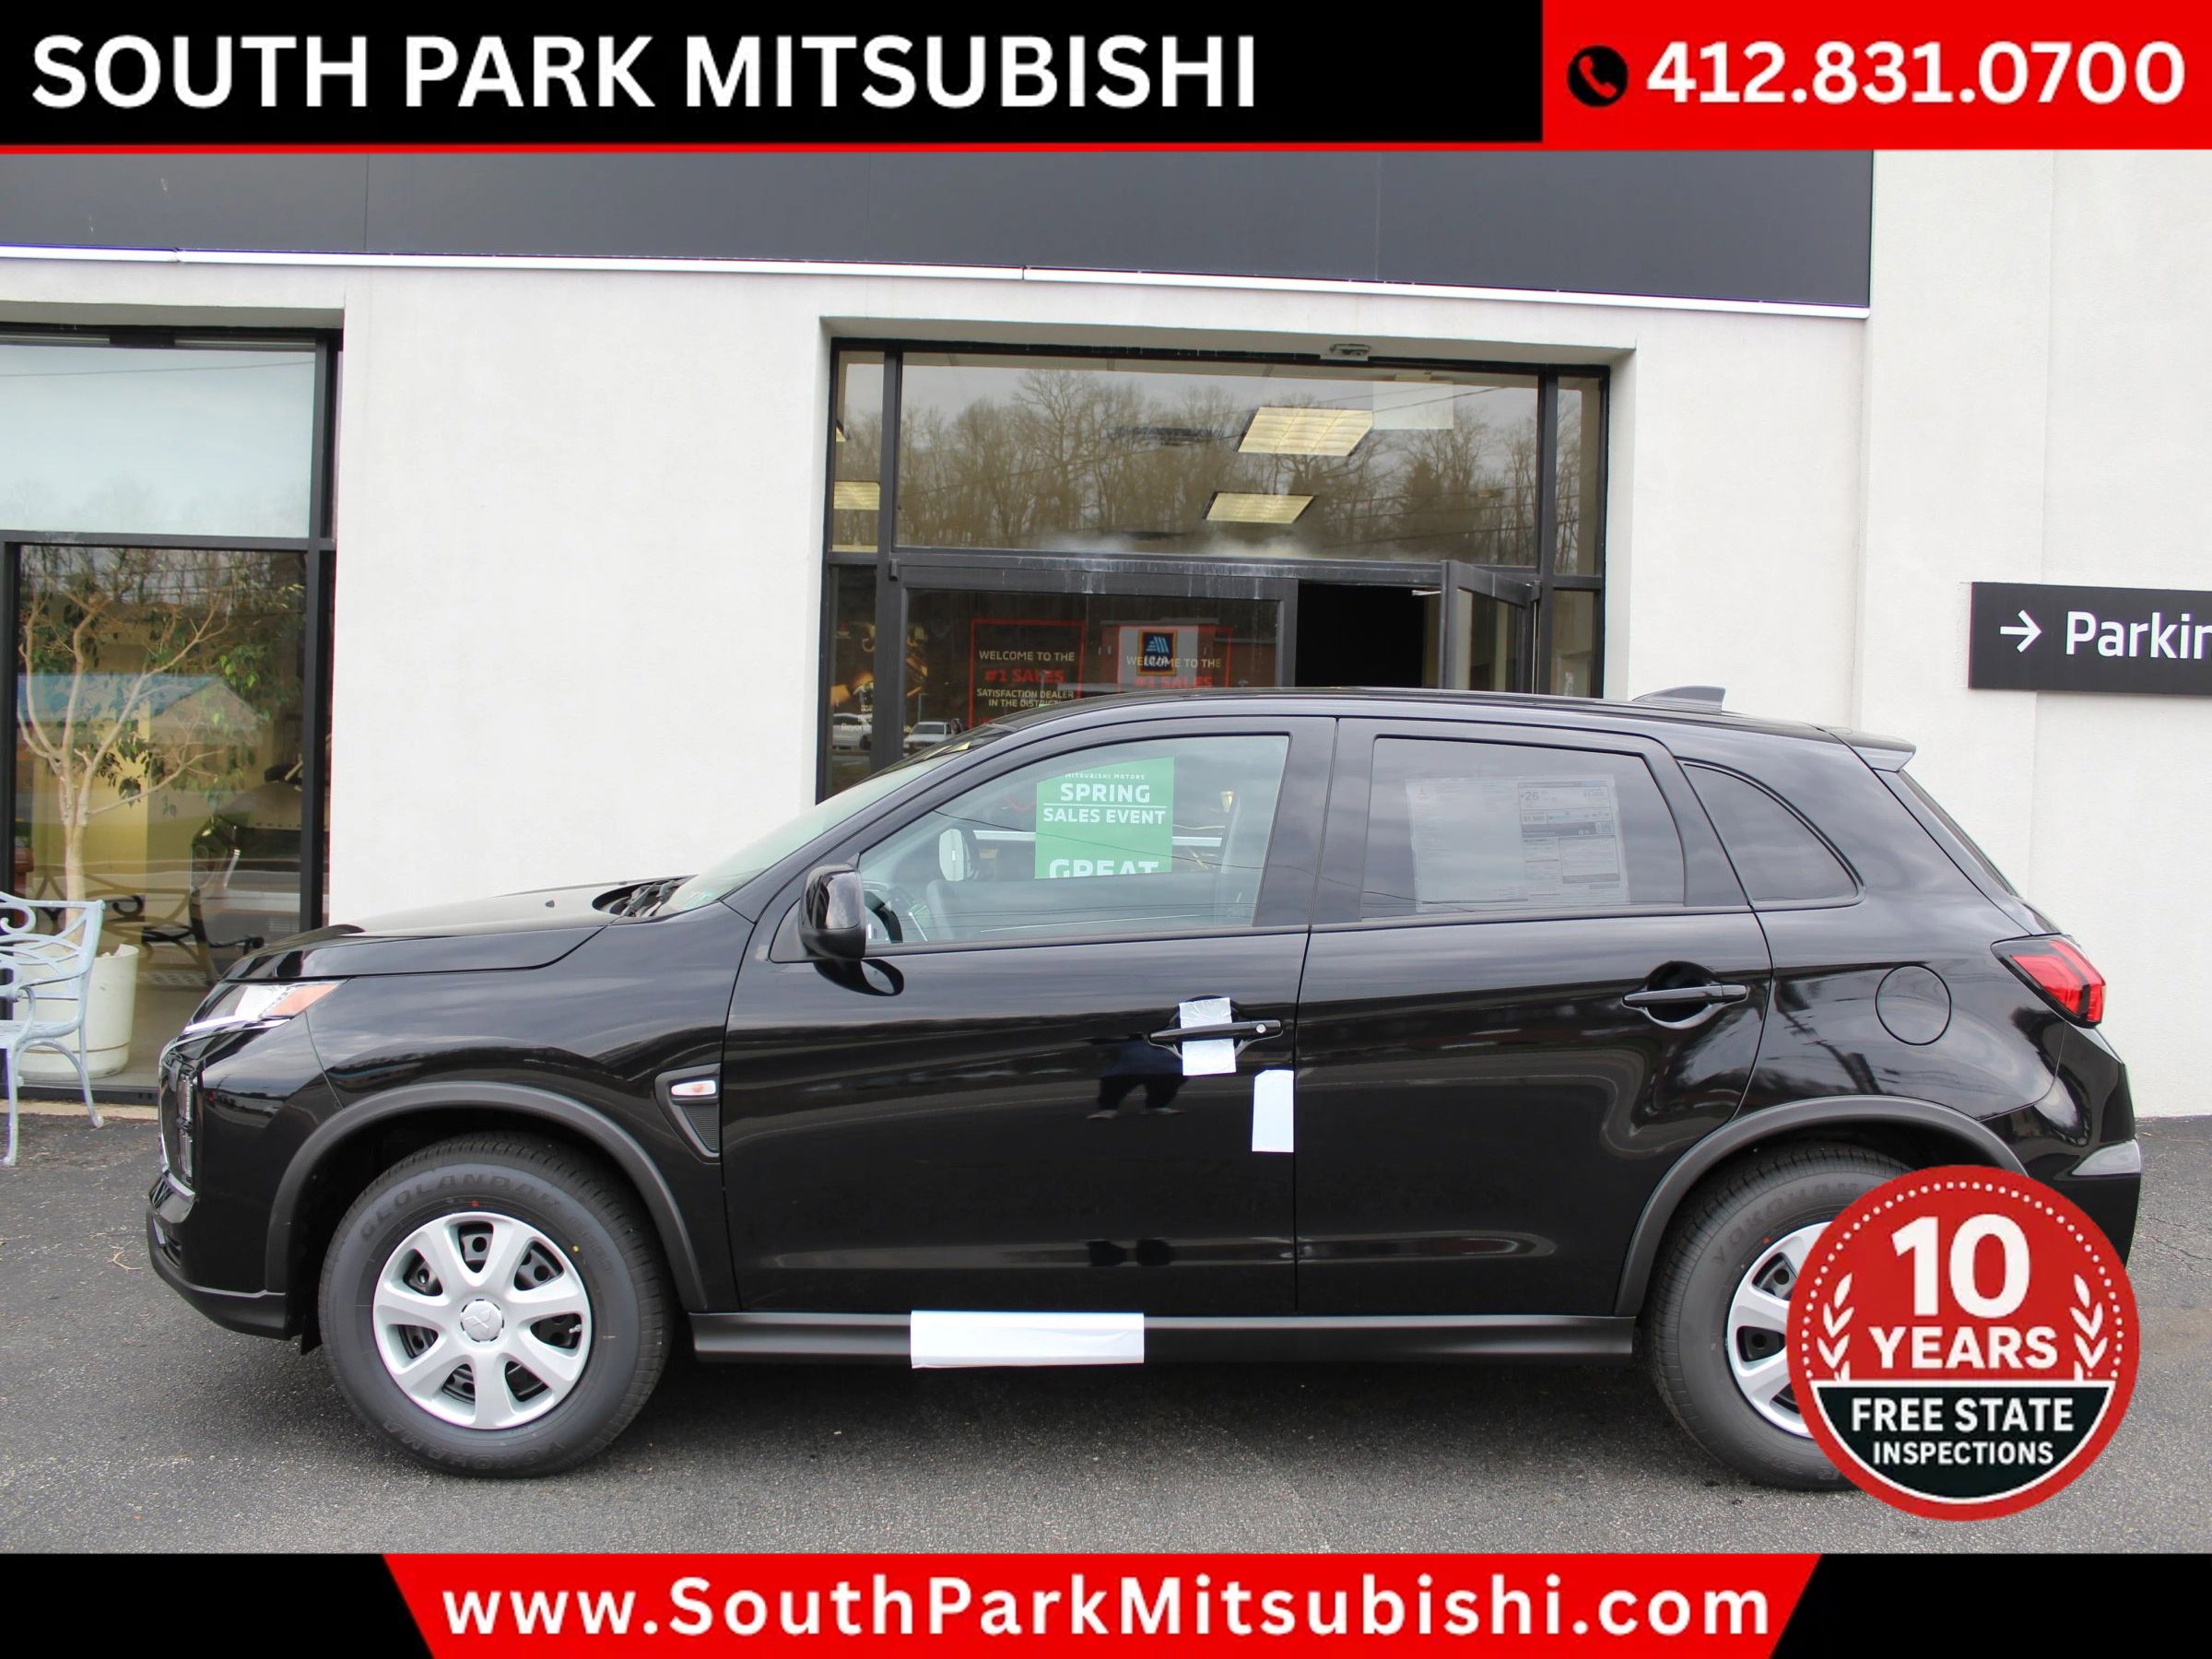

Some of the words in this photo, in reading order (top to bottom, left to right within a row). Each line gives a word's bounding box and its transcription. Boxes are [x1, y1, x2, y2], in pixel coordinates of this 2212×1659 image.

[979, 650, 1033, 661] WELCOME
[1037, 652, 1052, 662] TO
[1054, 652, 1076, 662] THE
[1183, 658, 1198, 668] TO
[1201, 658, 1221, 668] THE
[1012, 668, 1066, 683] SALES
[977, 688, 1038, 699] SATISFACTION
[1041, 690, 1075, 699] DEALER
[988, 699, 998, 708] IN
[1001, 699, 1018, 708] THE
[1061, 783, 1150, 803] SPRING
[1043, 807, 1100, 822] SALES
[1106, 809, 1166, 824] EVENT
